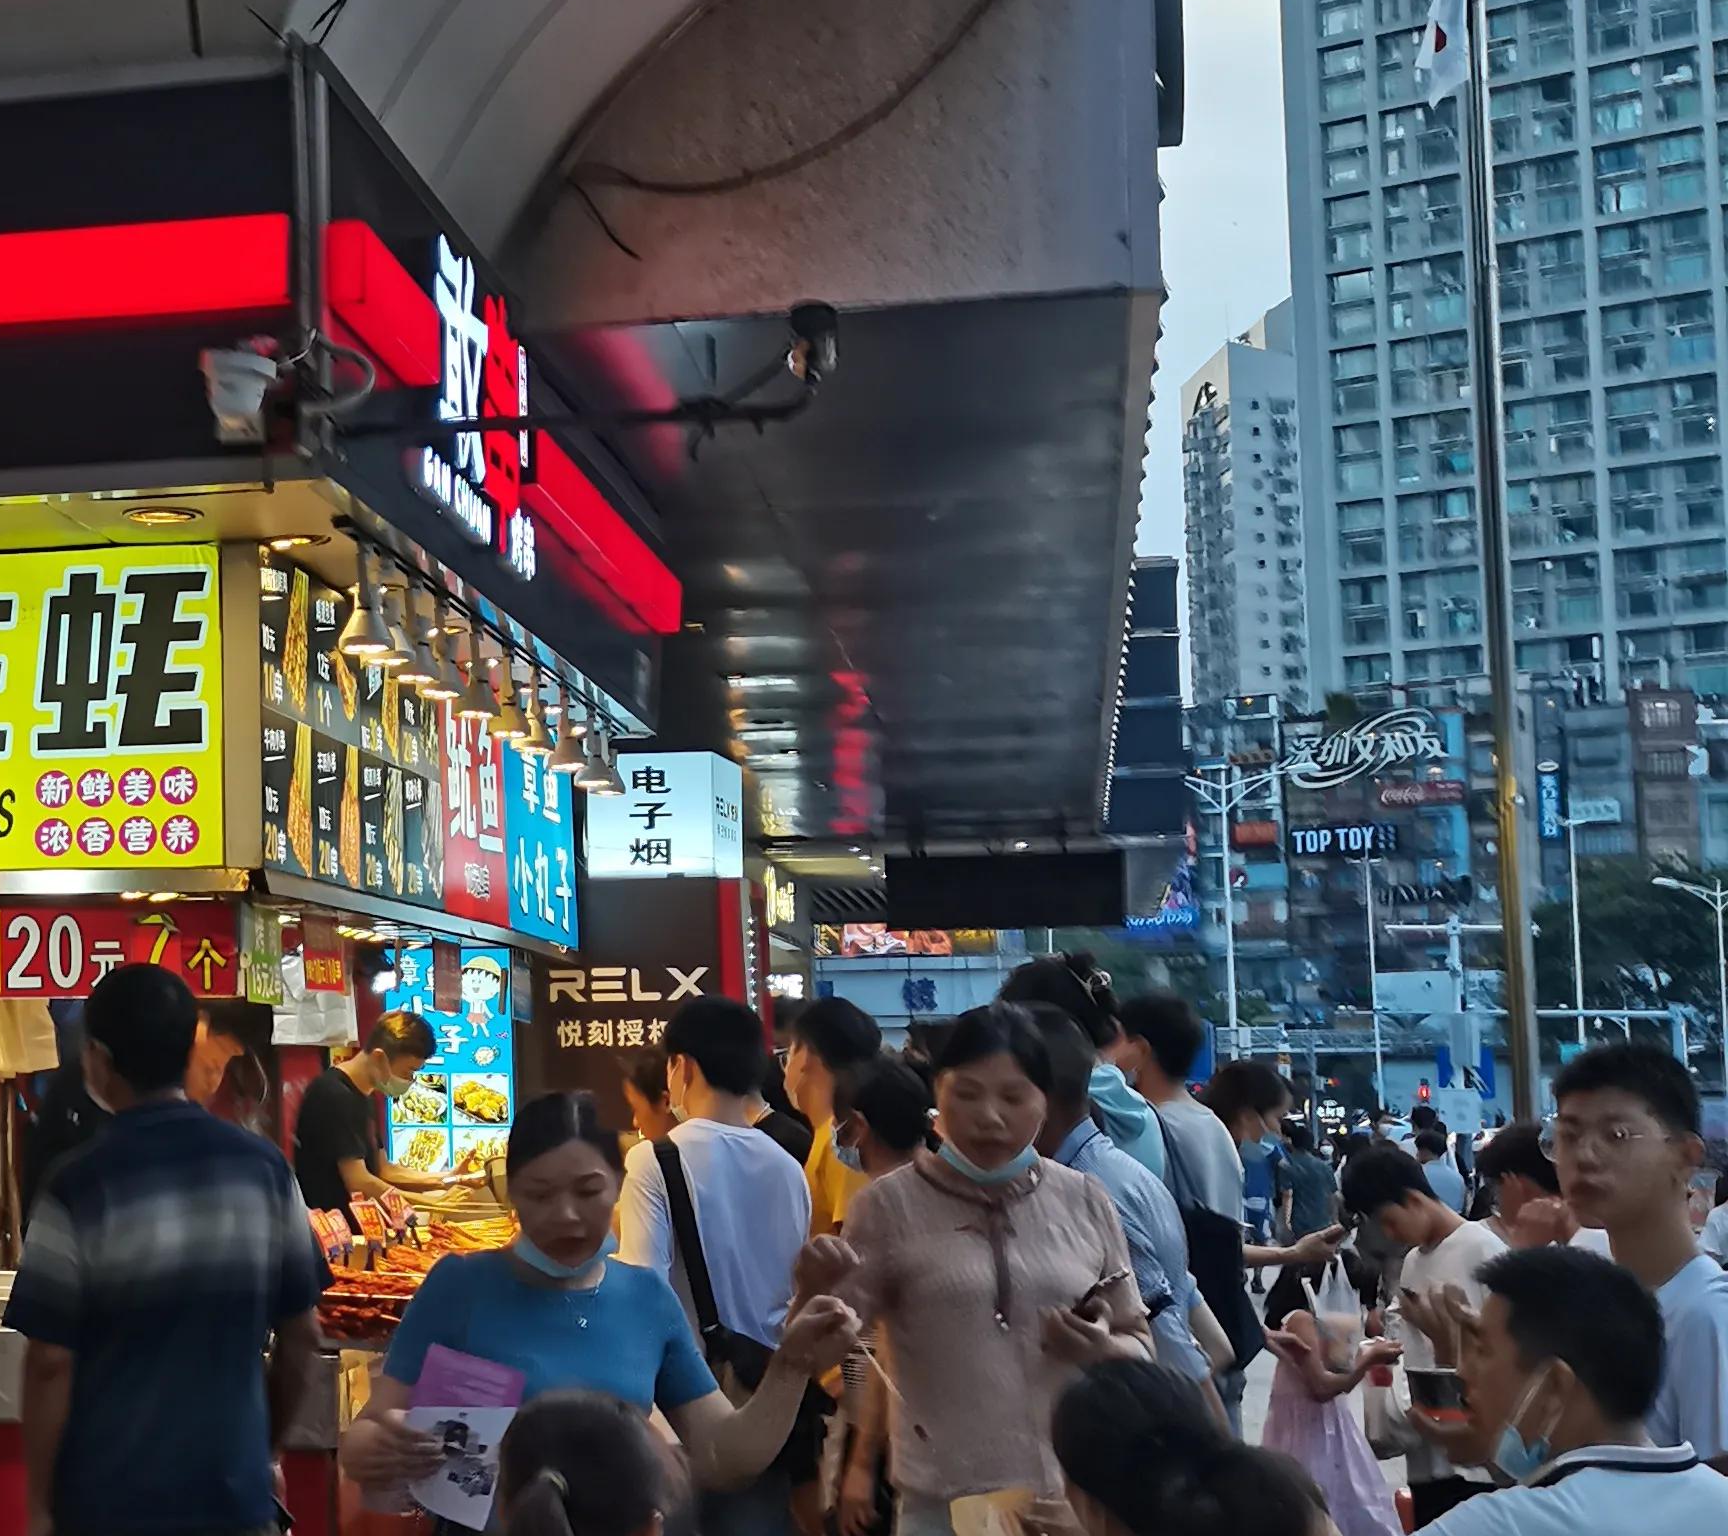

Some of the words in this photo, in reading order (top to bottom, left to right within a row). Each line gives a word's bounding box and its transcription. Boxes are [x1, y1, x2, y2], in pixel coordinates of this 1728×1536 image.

[1280, 728, 1450, 770] 深圳文和友
[40, 770, 194, 806] 新鲜美味
[445, 699, 504, 853] 鱿鱼
[629, 766, 672, 865] 电子烟
[39, 819, 194, 854] 浓香营养
[1292, 828, 1332, 854] TOP
[1334, 825, 1375, 852] TOY
[7, 914, 125, 989] 20元
[549, 966, 711, 1002] RELX
